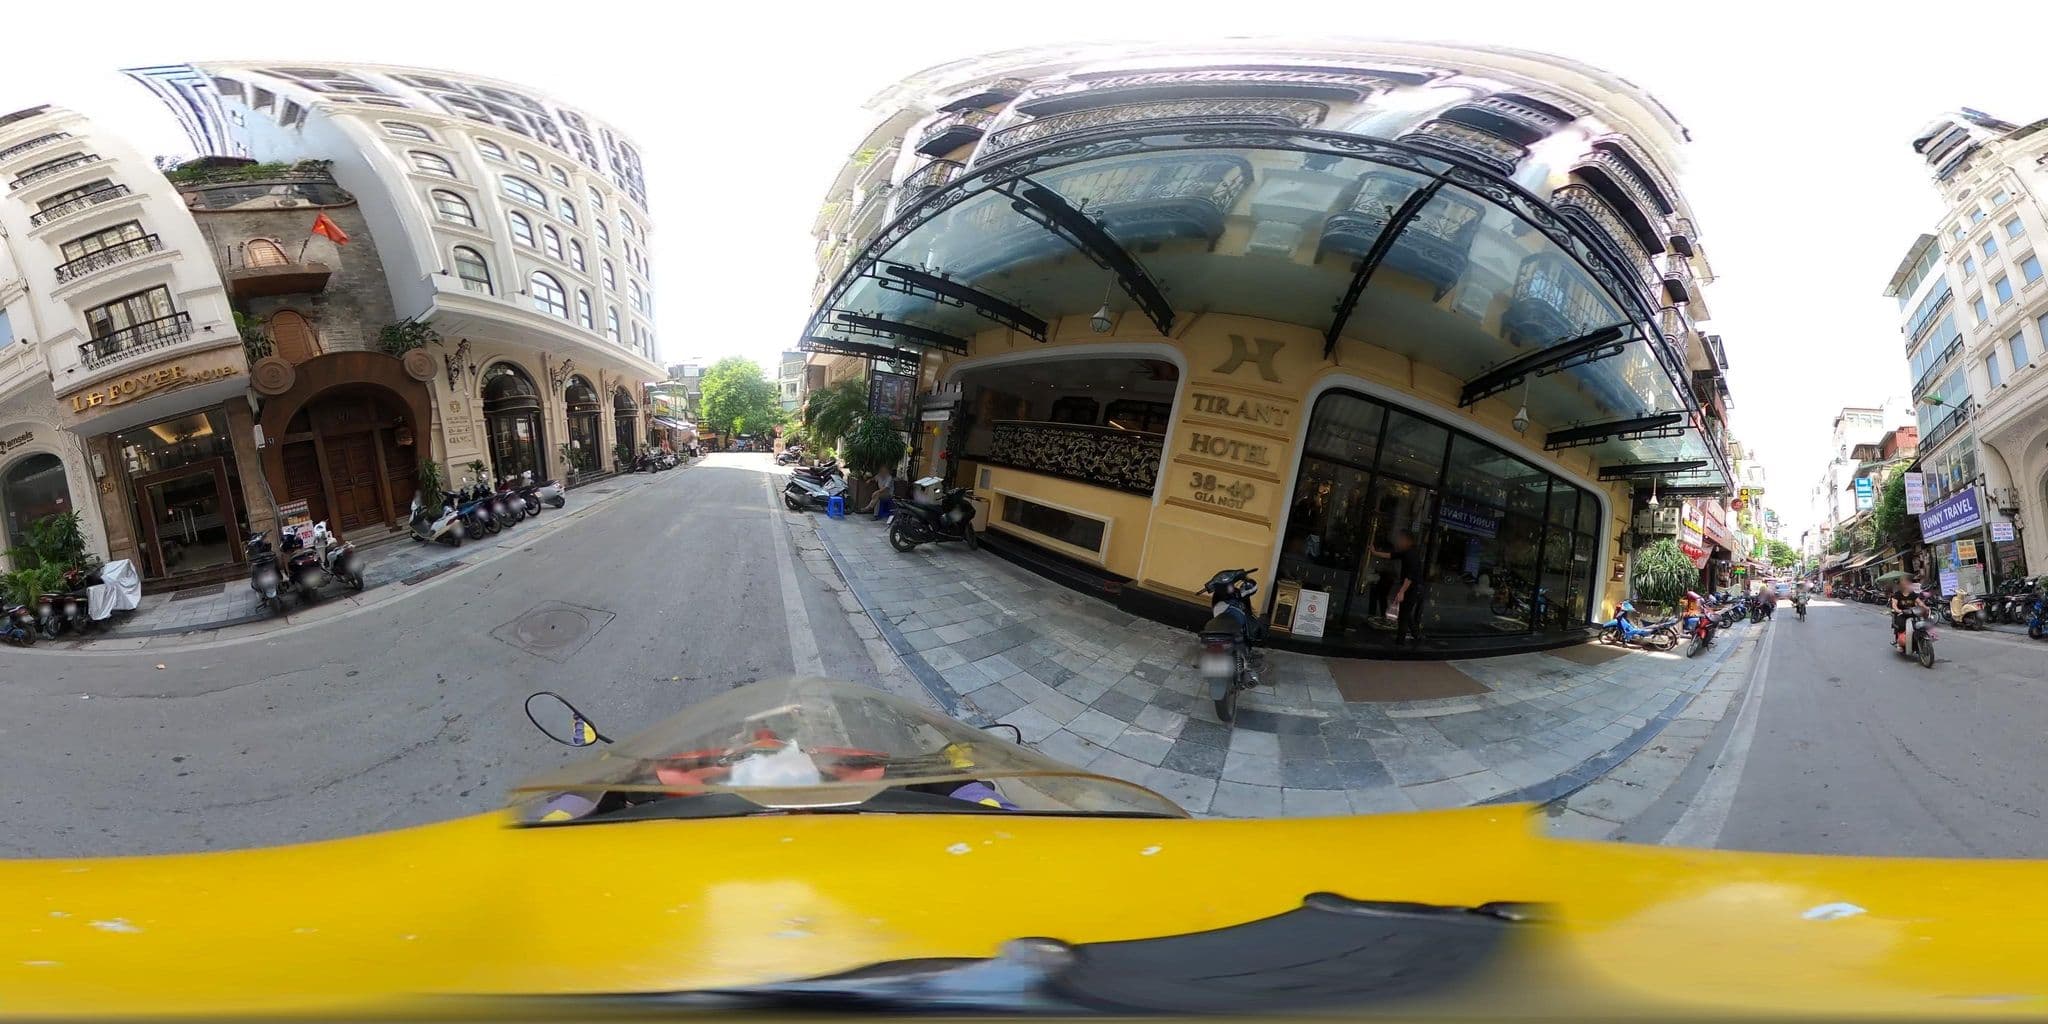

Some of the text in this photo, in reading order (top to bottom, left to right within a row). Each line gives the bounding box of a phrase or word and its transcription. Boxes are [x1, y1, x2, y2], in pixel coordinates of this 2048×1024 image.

[107, 366, 184, 400] FOYER
[191, 366, 238, 382] HOTEL
[1191, 393, 1290, 427] TIRANT
[1189, 433, 1269, 466] HOTEL
[1189, 471, 1255, 500] 38-40
[1194, 491, 1216, 504] GIA
[1922, 498, 1972, 530] FUNNY TRAVEL
